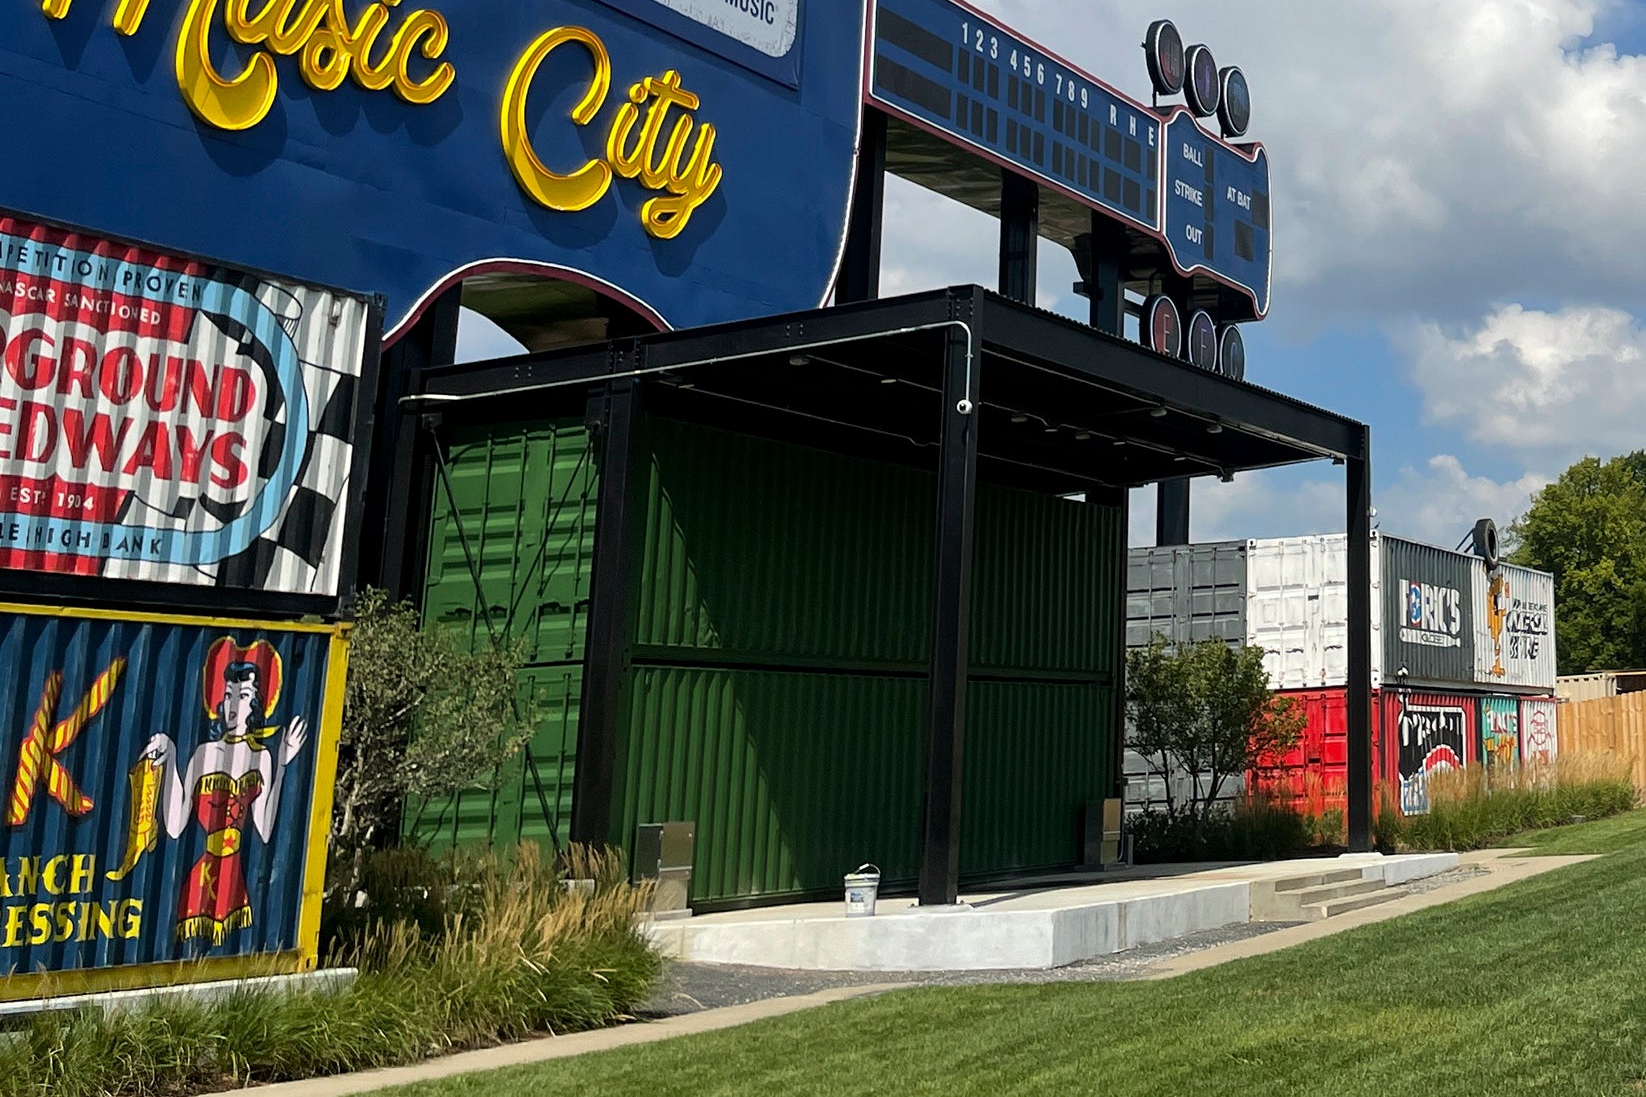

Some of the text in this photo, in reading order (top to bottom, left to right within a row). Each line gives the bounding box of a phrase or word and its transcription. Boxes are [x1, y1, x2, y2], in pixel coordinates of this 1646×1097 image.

[962, 22, 1154, 147] 1 2 3 4 5 6 7 8 9 R H E
[501, 25, 722, 239] City
[1183, 143, 1203, 167] BALL
[1174, 179, 1203, 207] STRIKE
[1226, 186, 1251, 210] AT BAT
[1185, 224, 1202, 245] OUT
[123, 269, 201, 300] PROVEN
[65, 293, 161, 326] SANCTIONED
[0, 324, 256, 423] GROUND
[57, 492, 94, 511] 1904
[102, 531, 162, 554] BANK
[7, 655, 127, 826] K
